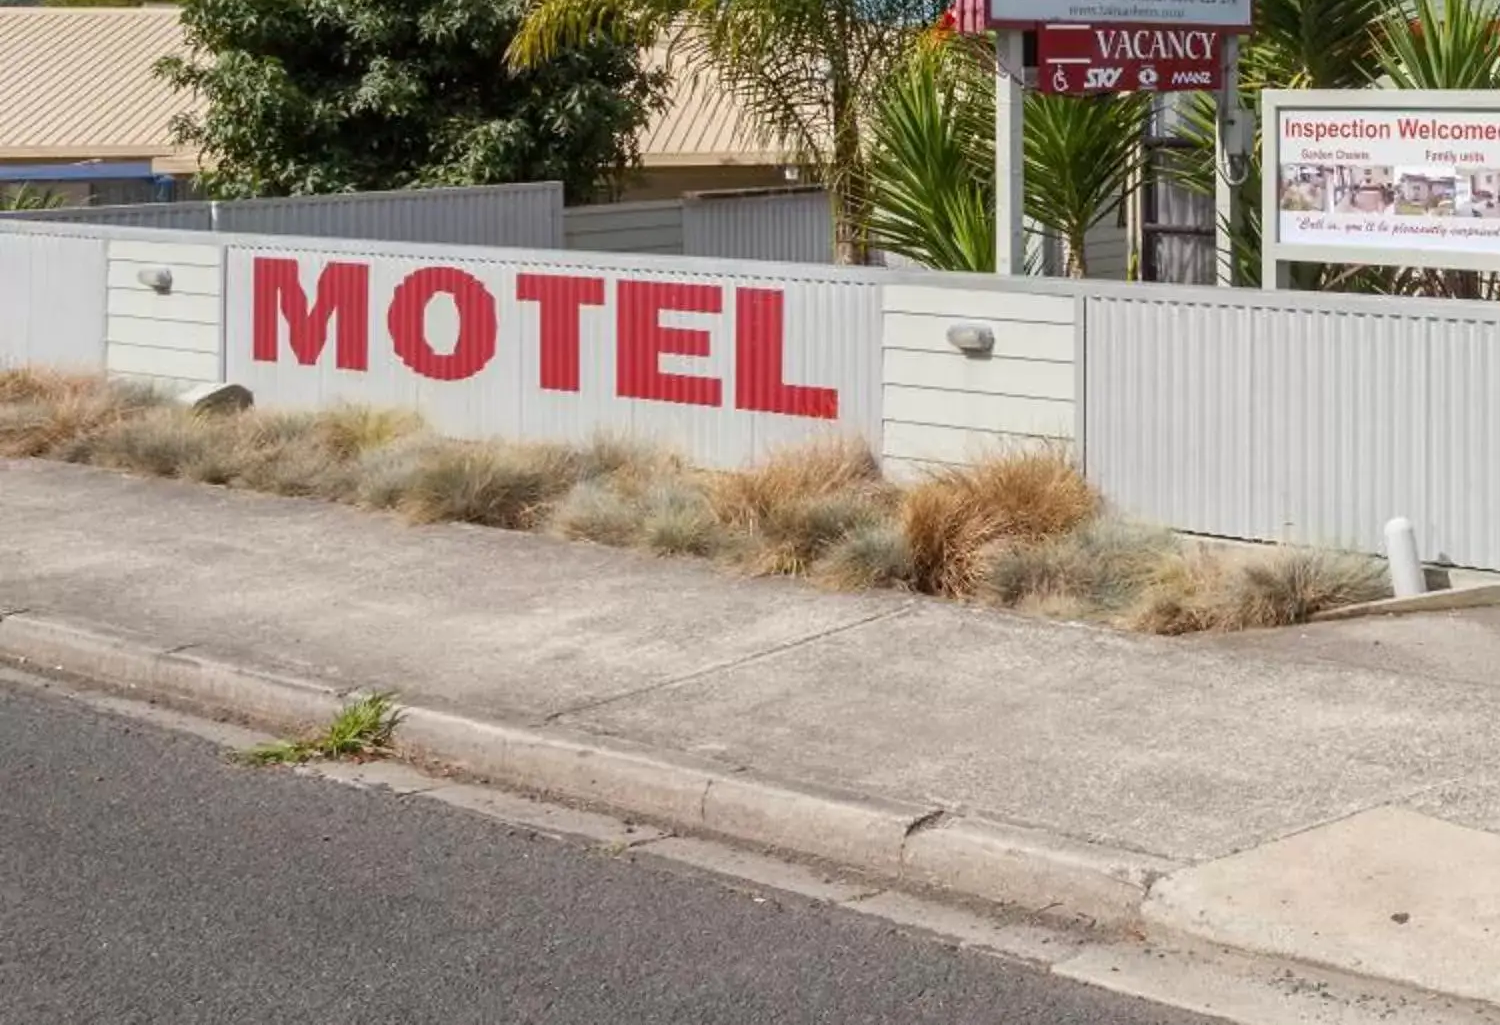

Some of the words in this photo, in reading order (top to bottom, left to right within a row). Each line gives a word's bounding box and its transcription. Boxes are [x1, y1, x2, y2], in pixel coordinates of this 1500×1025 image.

[1095, 30, 1216, 60] VACANCY
[1083, 67, 1124, 88] SKY
[1285, 118, 1391, 142] Inspection
[1425, 149, 1456, 164] Family
[253, 256, 839, 420] MOTEL
